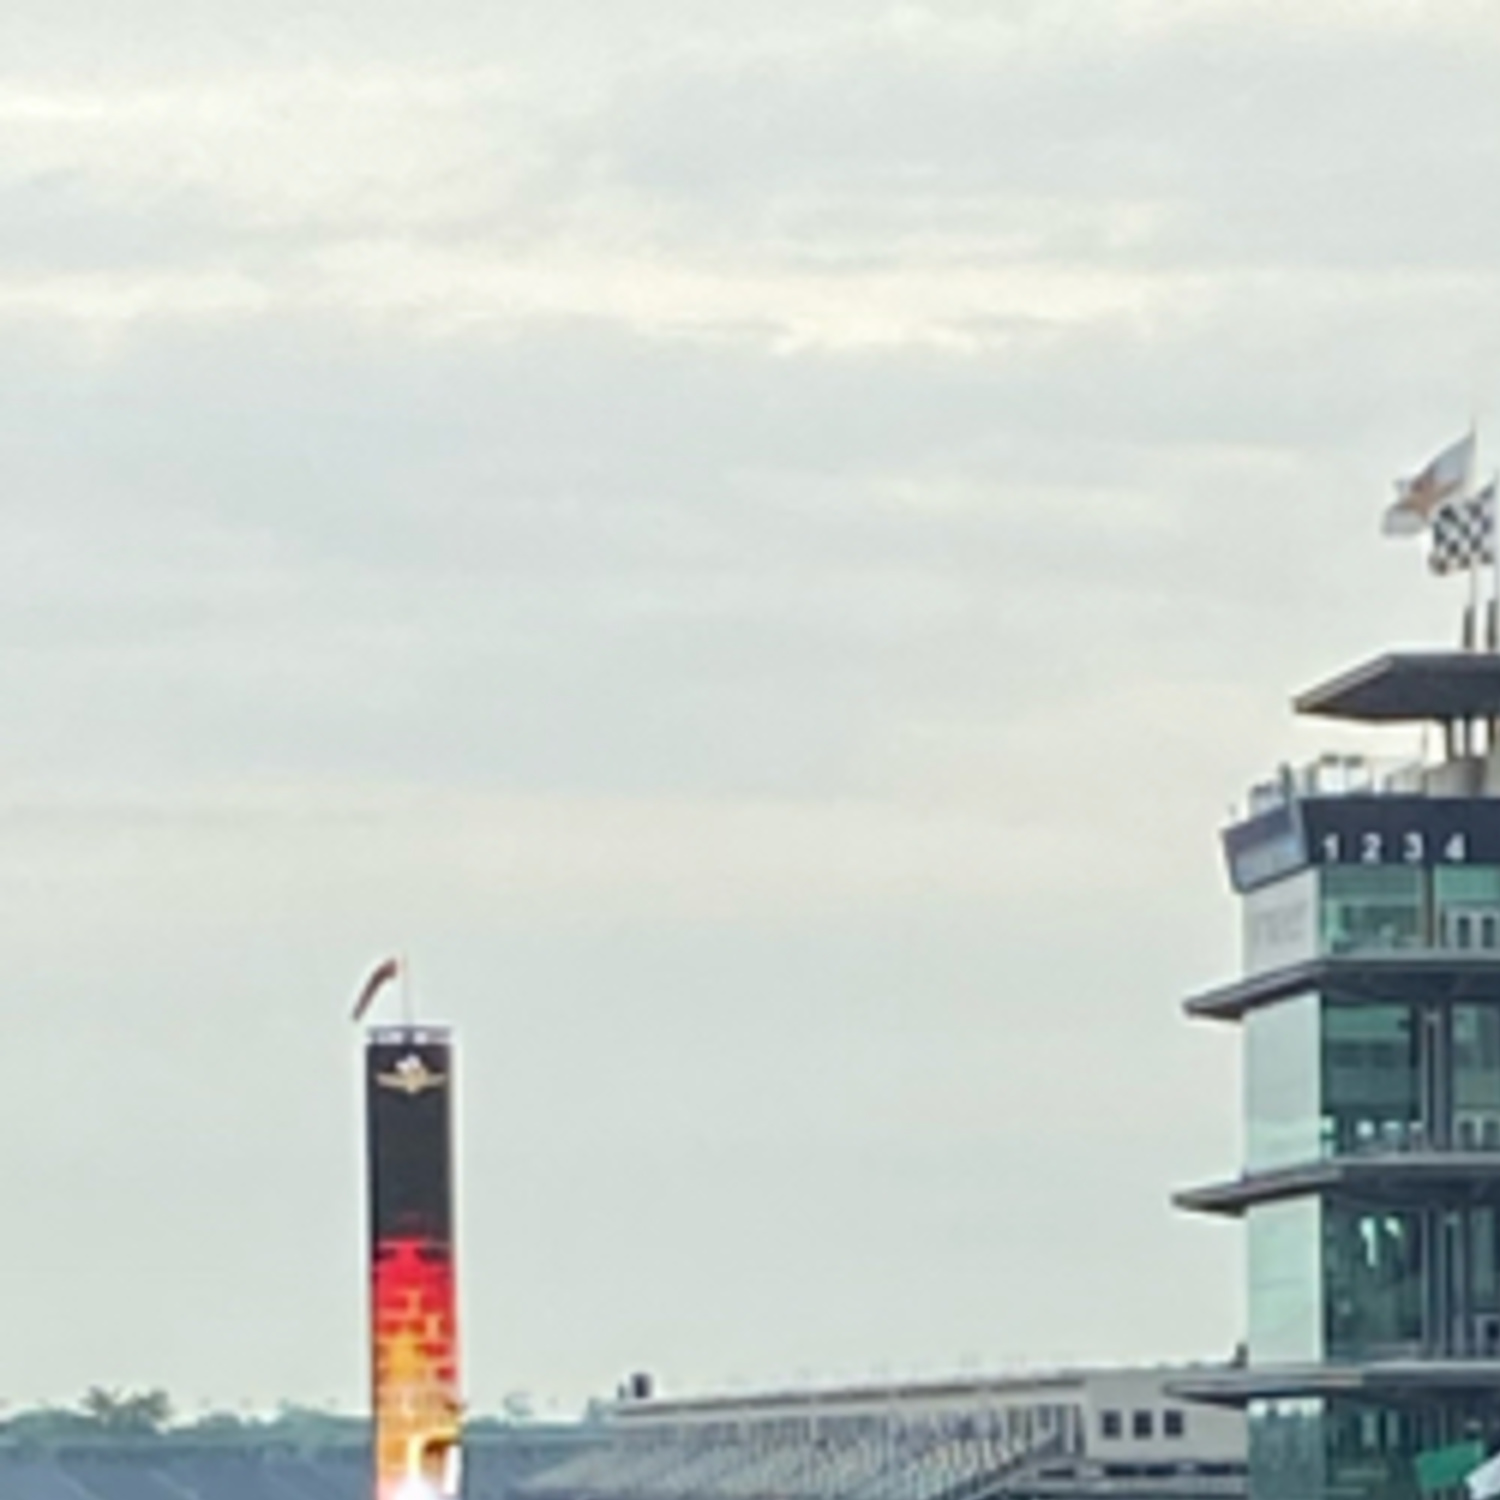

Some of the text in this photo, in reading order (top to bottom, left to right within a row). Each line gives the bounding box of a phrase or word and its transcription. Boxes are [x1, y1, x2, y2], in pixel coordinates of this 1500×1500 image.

[1322, 831, 1467, 864] 1 2 3 4
